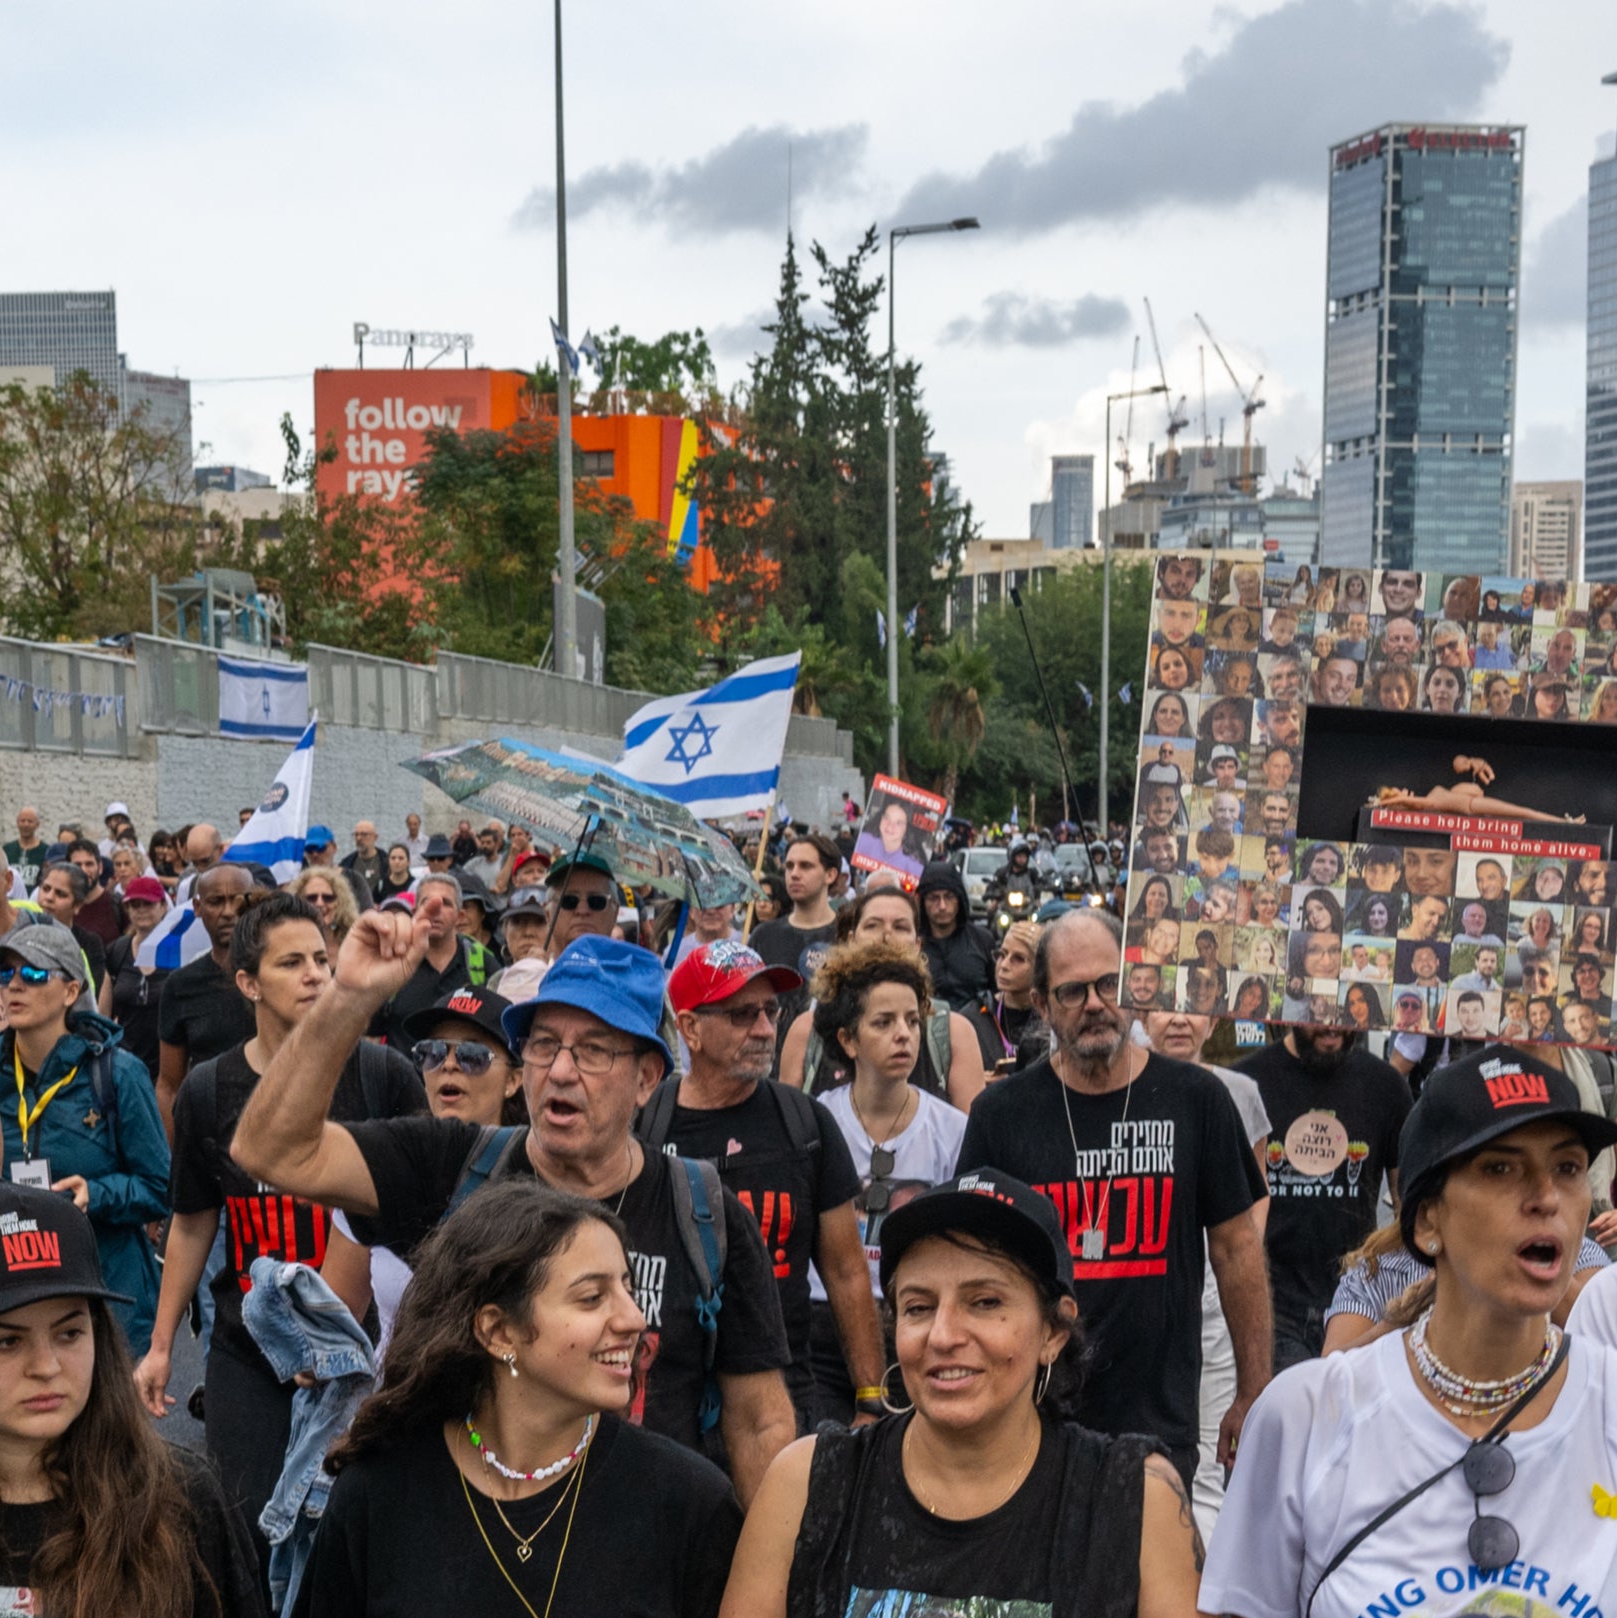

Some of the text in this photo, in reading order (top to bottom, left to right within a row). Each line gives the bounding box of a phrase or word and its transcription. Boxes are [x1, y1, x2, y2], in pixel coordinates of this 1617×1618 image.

[353, 321, 475, 353] Panorays
[344, 398, 463, 430] follow
[346, 432, 406, 464] the
[879, 779, 942, 811] KIDNAPPED
[1379, 810, 1520, 835] Please help bring
[1456, 834, 1593, 858] them home alive.
[447, 997, 483, 1015] NOW
[1485, 1073, 1549, 1100] NOW
[1111, 1119, 1175, 1148] מחזירים
[1302, 1133, 1332, 1147] רוצה
[1310, 1122, 1329, 1134] אני
[1076, 1146, 1175, 1178] אותם הביתה
[1294, 1144, 1336, 1159] הביתה
[1292, 1185, 1344, 1198] NOT TO
[2, 1230, 60, 1264] NOW
[1435, 1558, 1551, 1598] OMER
